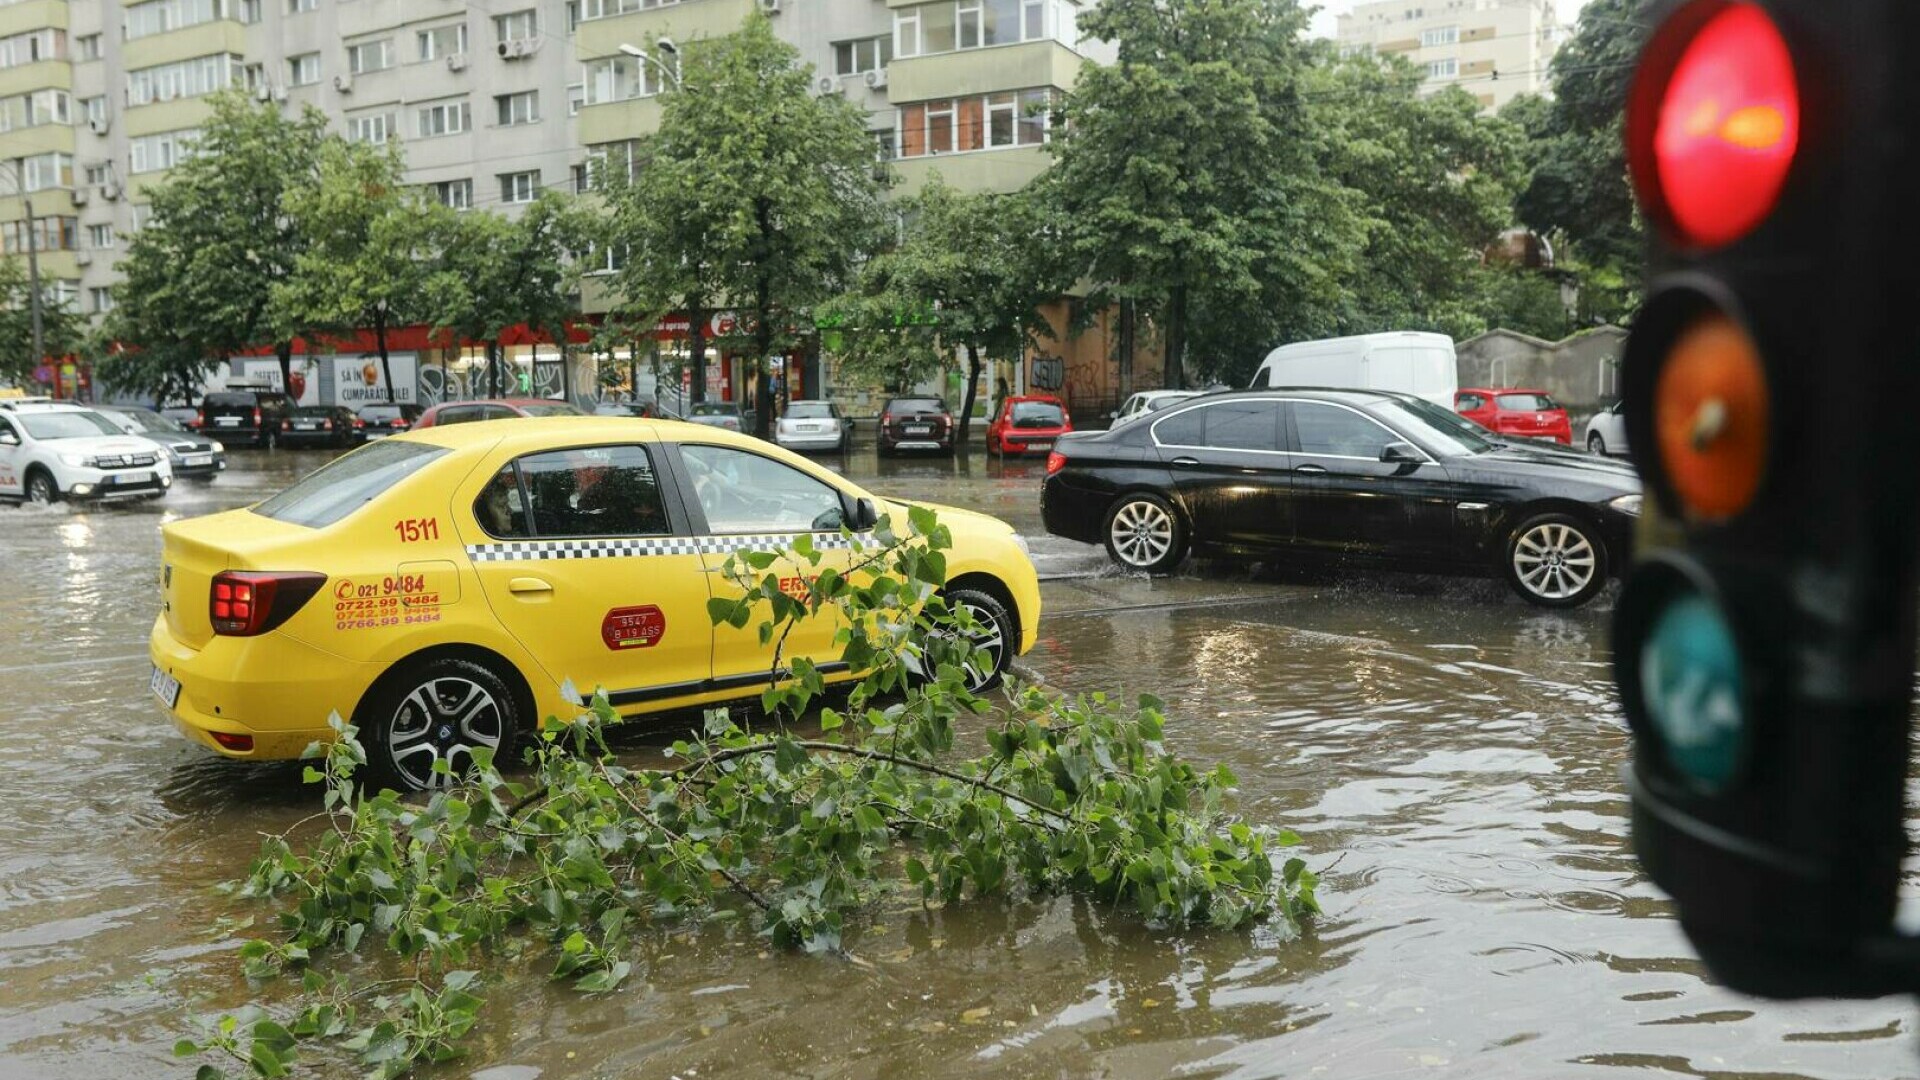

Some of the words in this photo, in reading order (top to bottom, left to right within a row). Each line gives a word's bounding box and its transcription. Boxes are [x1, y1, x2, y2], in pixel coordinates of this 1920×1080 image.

[394, 517, 439, 543] 1511
[357, 584, 378, 597] 021
[383, 574, 425, 595] 9484
[335, 598, 398, 611] 0722.99
[404, 595, 439, 605] 9484
[336, 608, 398, 620] 0742.99
[336, 616, 399, 630] 0766.99
[405, 614, 441, 624] 9484
